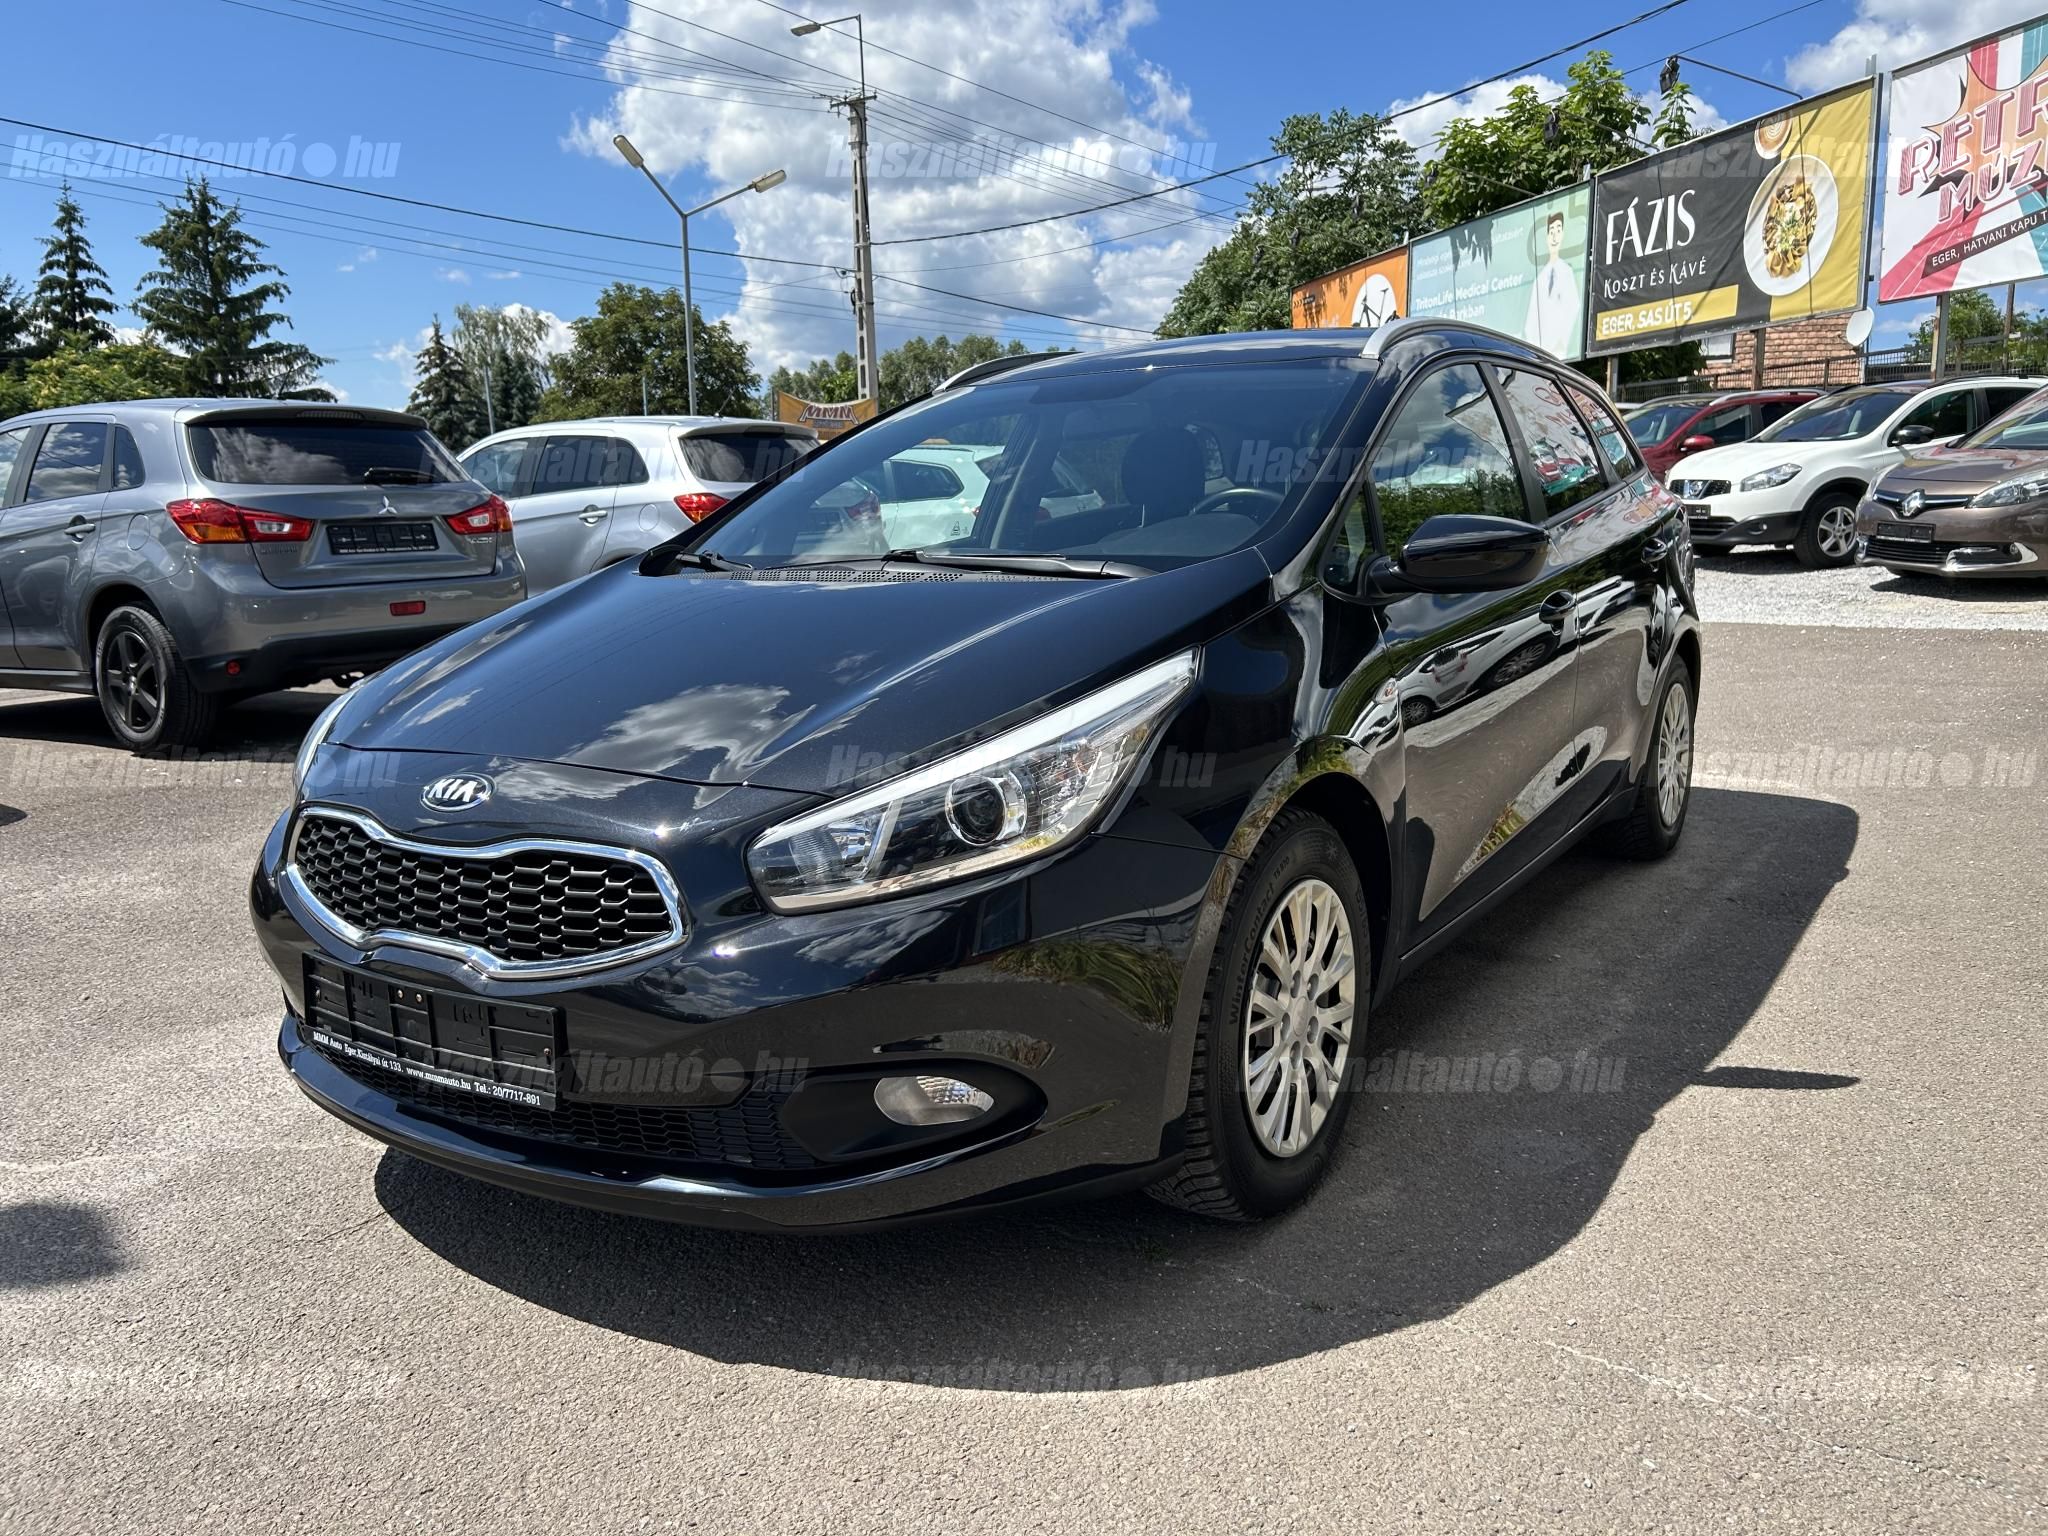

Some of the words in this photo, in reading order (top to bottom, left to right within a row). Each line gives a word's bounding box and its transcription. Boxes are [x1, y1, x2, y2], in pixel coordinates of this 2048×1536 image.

[1606, 190, 1695, 265] FÁZIS
[1932, 249, 1960, 266] EGER,
[1963, 228, 2007, 254] HATVANI
[2010, 214, 2037, 235] KAPU
[1415, 289, 1454, 312] TritonLife
[1455, 279, 1490, 301] Medical
[1491, 273, 1524, 292] Center
[1604, 274, 1646, 299] KOSZT
[1650, 267, 1665, 286] ÉS
[1669, 256, 1706, 285] KÁVÉ
[1637, 307, 1664, 328] SAS
[799, 404, 859, 424] MMM
[427, 779, 477, 802] KIA
[313, 1031, 329, 1044] MMM
[330, 1038, 342, 1050] Auto
[406, 1067, 472, 1090] www.mmmauto.hu
[493, 1086, 541, 1105] 20/7717-891
